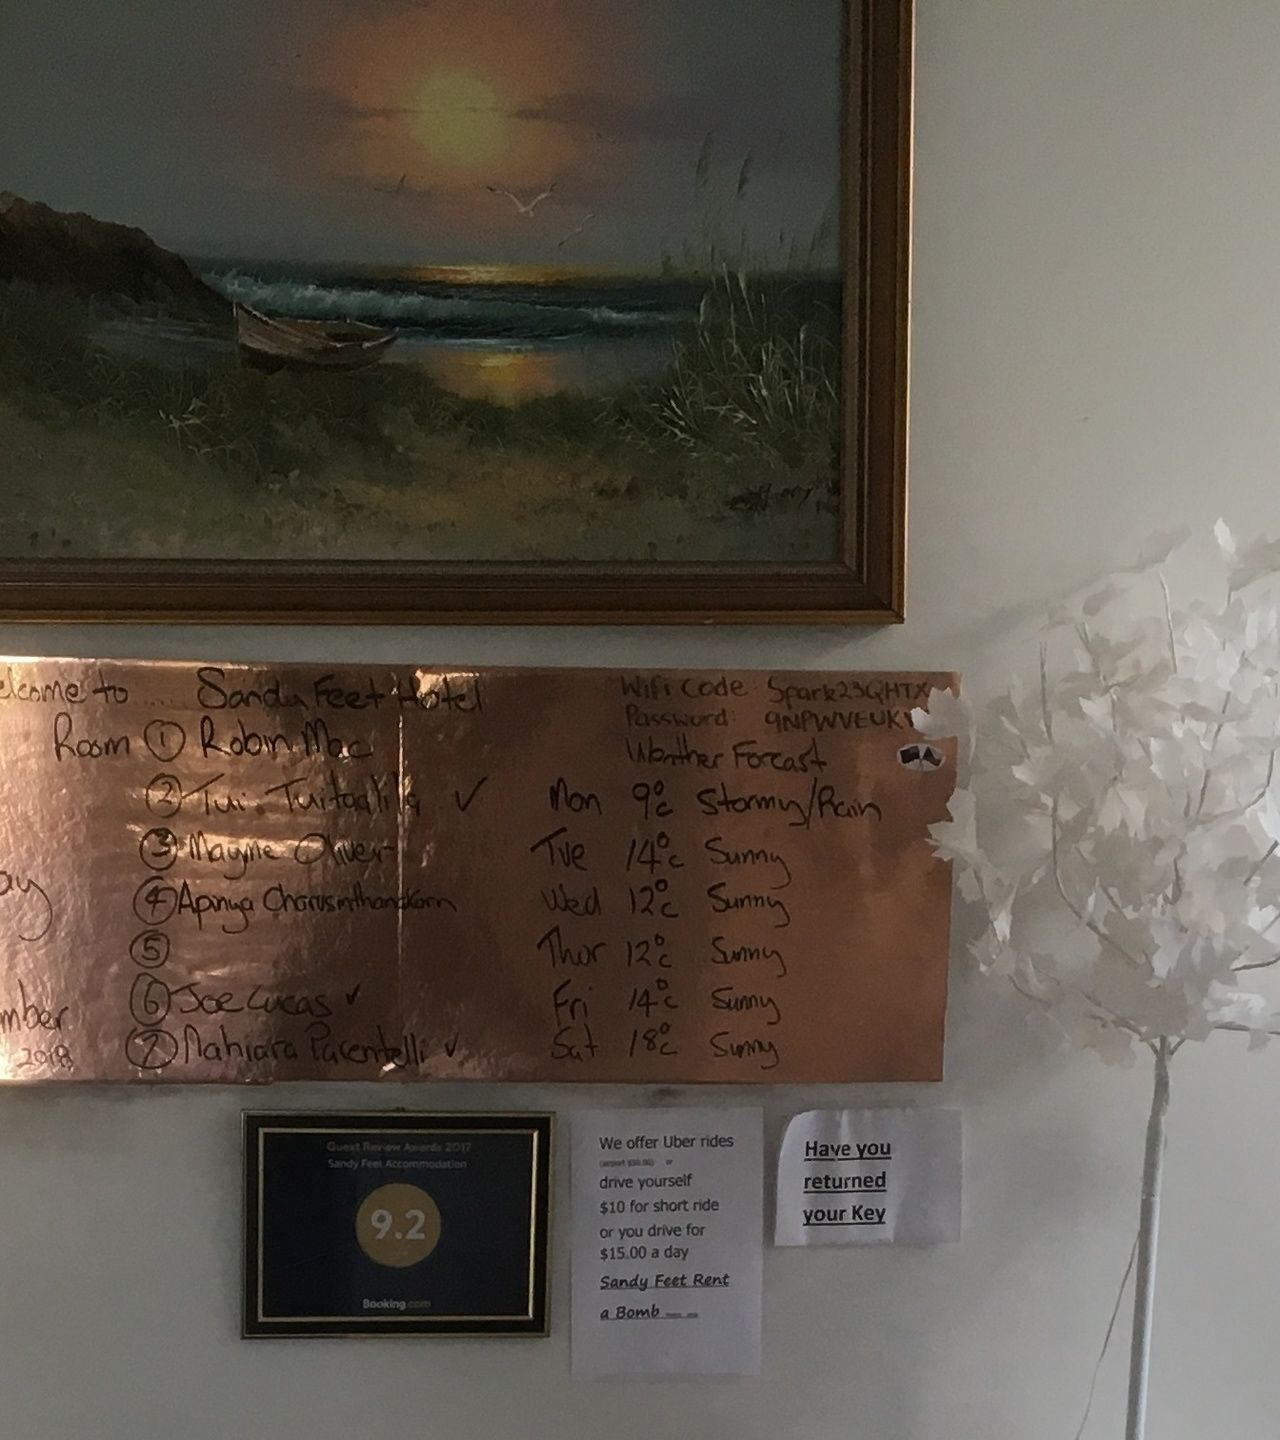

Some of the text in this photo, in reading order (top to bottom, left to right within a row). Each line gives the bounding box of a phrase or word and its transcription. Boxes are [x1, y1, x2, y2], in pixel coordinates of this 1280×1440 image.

[92, 668, 129, 704] to
[313, 673, 387, 710] Feet
[398, 670, 483, 712] Hotel
[53, 711, 131, 762] Room
[199, 714, 294, 760] Robin
[301, 716, 374, 759] Mac
[731, 737, 828, 774] Forcast
[548, 776, 603, 815] Mon
[529, 826, 588, 872] Tue
[704, 836, 793, 891] Sunny
[540, 882, 603, 917] Wed
[707, 881, 792, 929] Sunny
[710, 935, 788, 979] Sunny
[170, 982, 245, 1015] Joe
[246, 984, 334, 1019] Lucas
[552, 978, 596, 1028] Fri
[710, 985, 783, 1027] Sunny
[550, 1022, 600, 1062] Sat
[708, 1030, 782, 1071] Sunny
[598, 1133, 736, 1150] We offer Uber rides
[804, 1139, 892, 1160] Have you
[327, 1158, 358, 1170] Sandy
[599, 1172, 694, 1191] drive yourself
[803, 1170, 887, 1190] returned
[599, 1197, 720, 1216] $10 for short ride
[802, 1204, 887, 1226] your Key
[370, 1208, 426, 1241] 9.2
[599, 1222, 707, 1241] or you drive for
[599, 1244, 690, 1262] $15.00 a day
[599, 1272, 731, 1291] Sandy Feet Rent
[599, 1308, 610, 1321] a
[615, 1303, 661, 1320] Bomb
